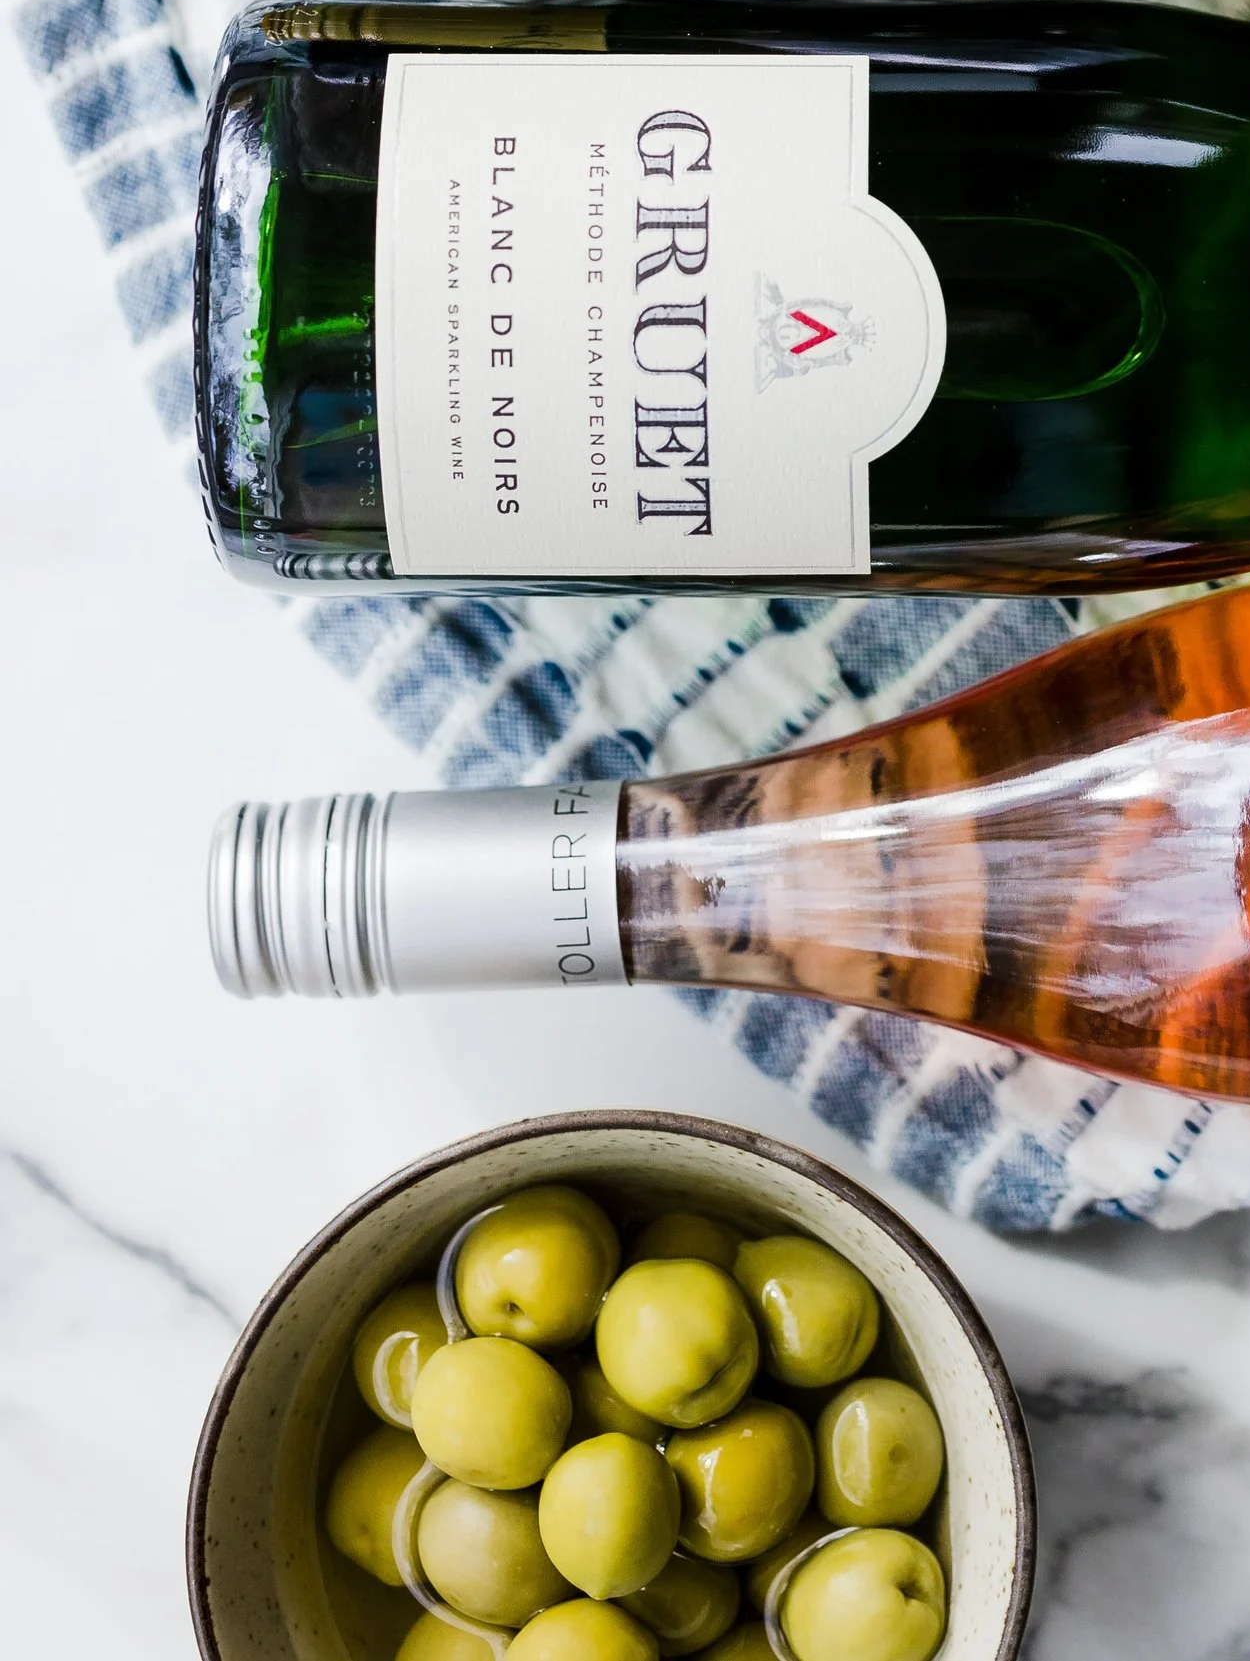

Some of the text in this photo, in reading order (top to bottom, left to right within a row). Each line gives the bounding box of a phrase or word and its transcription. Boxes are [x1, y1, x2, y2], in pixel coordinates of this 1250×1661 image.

[447, 179, 464, 480] AMERICAN SPARKLING WINE
[490, 137, 520, 515] BLANC DE NOIRS
[587, 144, 610, 509] MÉTHODE CHAMPENOISE
[632, 109, 713, 537] GRUET
